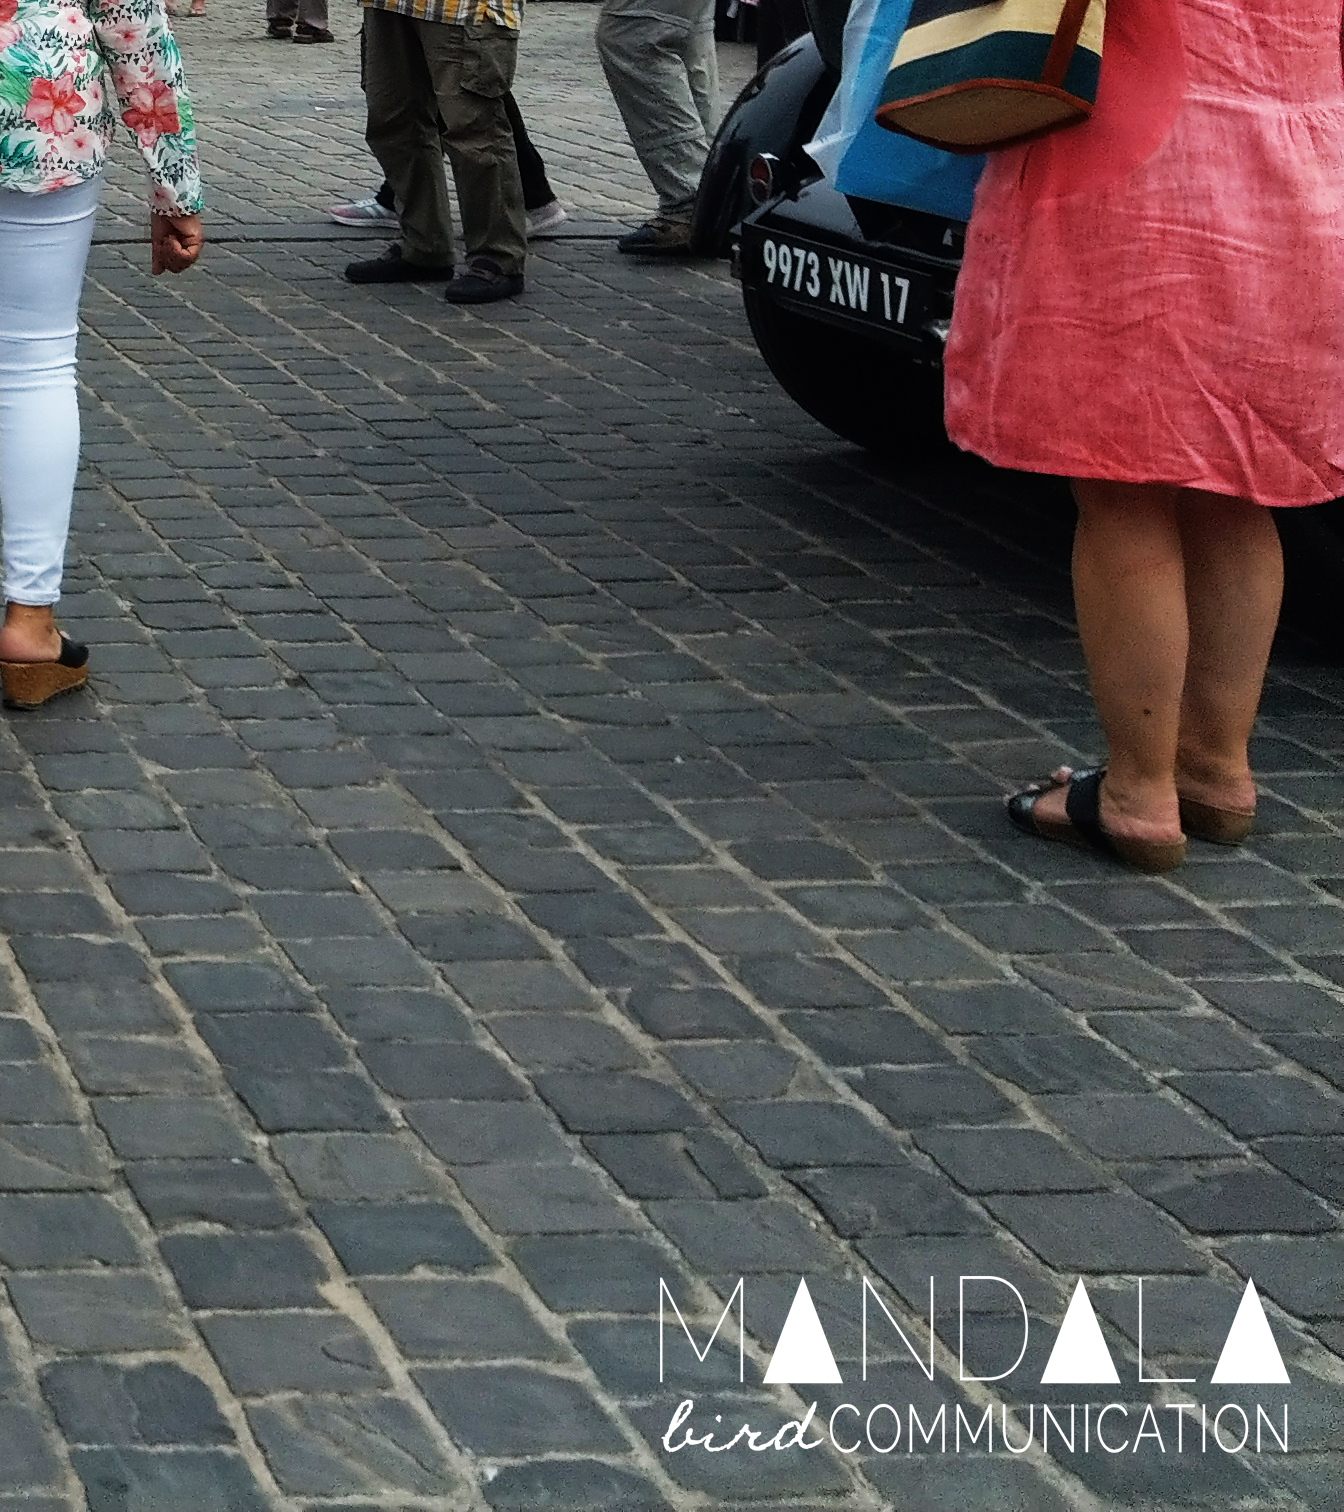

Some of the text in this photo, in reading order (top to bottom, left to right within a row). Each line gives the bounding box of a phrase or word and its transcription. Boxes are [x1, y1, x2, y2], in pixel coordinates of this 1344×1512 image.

[763, 239, 910, 324] 9973 XW 17
